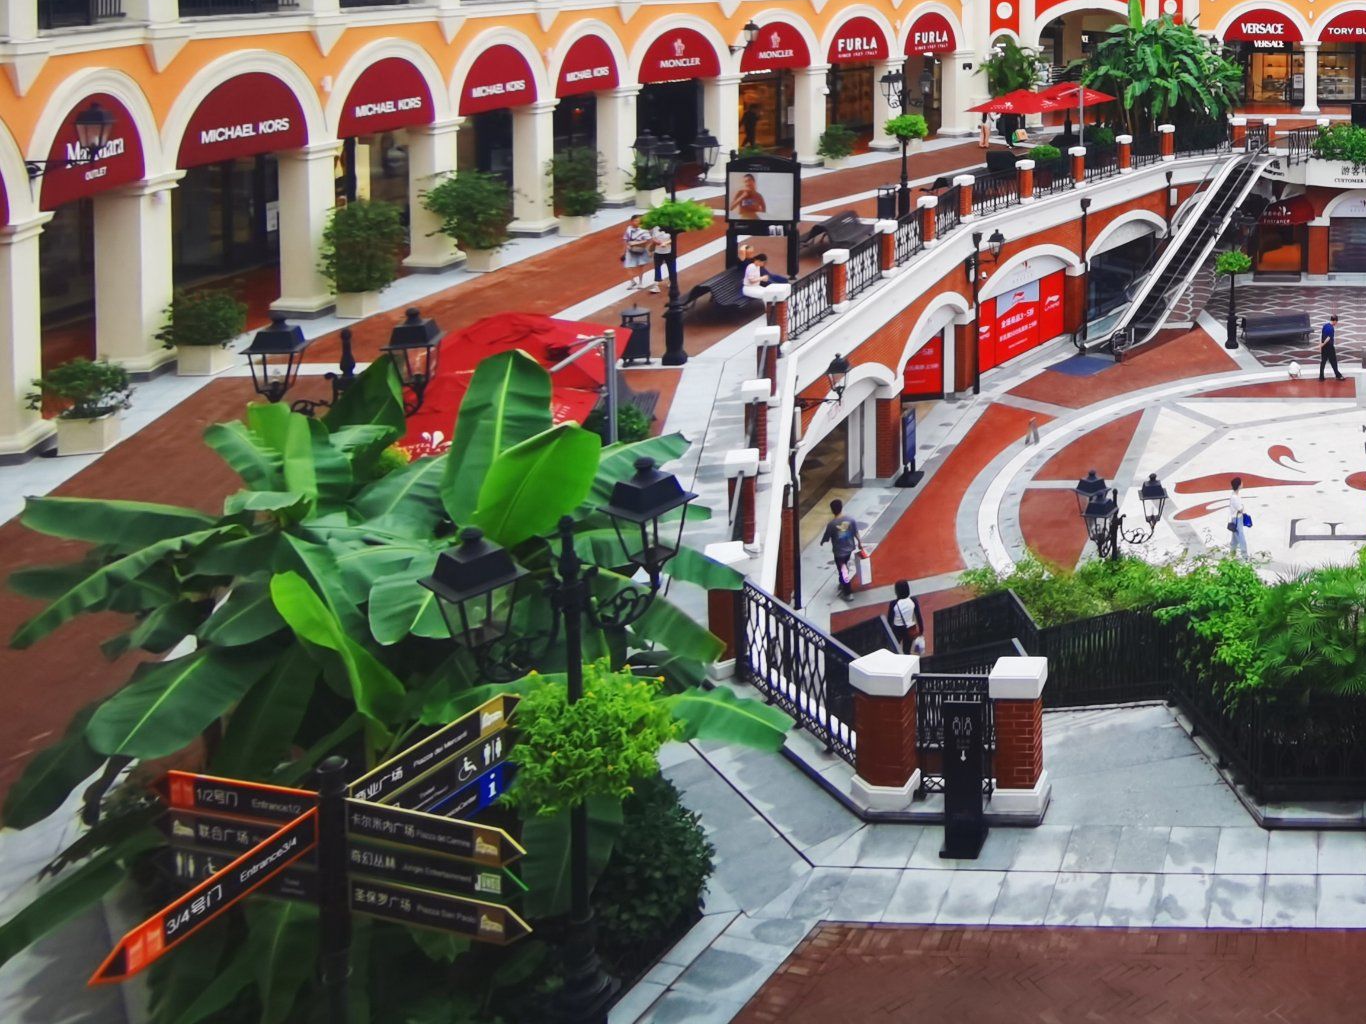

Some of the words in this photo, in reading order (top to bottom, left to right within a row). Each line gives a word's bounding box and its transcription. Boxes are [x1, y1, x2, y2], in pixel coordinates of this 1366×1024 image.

[914, 30, 949, 45] FURLA
[1241, 22, 1284, 34] VERSACE
[1328, 27, 1353, 35] TORY
[758, 49, 794, 59] MONCLER
[837, 36, 878, 52] FURLA
[659, 57, 701, 69] MONCLER
[472, 82, 506, 98] MICHAEL
[505, 79, 526, 91] KORS
[355, 100, 397, 118] MICHAEL
[397, 96, 422, 111] KORS
[200, 123, 257, 145] MICHAEL
[258, 117, 290, 135] KORS
[354, 766, 404, 801] 商业广场
[196, 787, 238, 807] 1/2号门
[199, 823, 249, 845] 联合广场
[351, 813, 415, 838] 卡尔米内广场
[351, 849, 396, 869] 奇幻丛林
[166, 883, 223, 935] 3/4号门
[354, 887, 412, 913] 圣保罗广场
